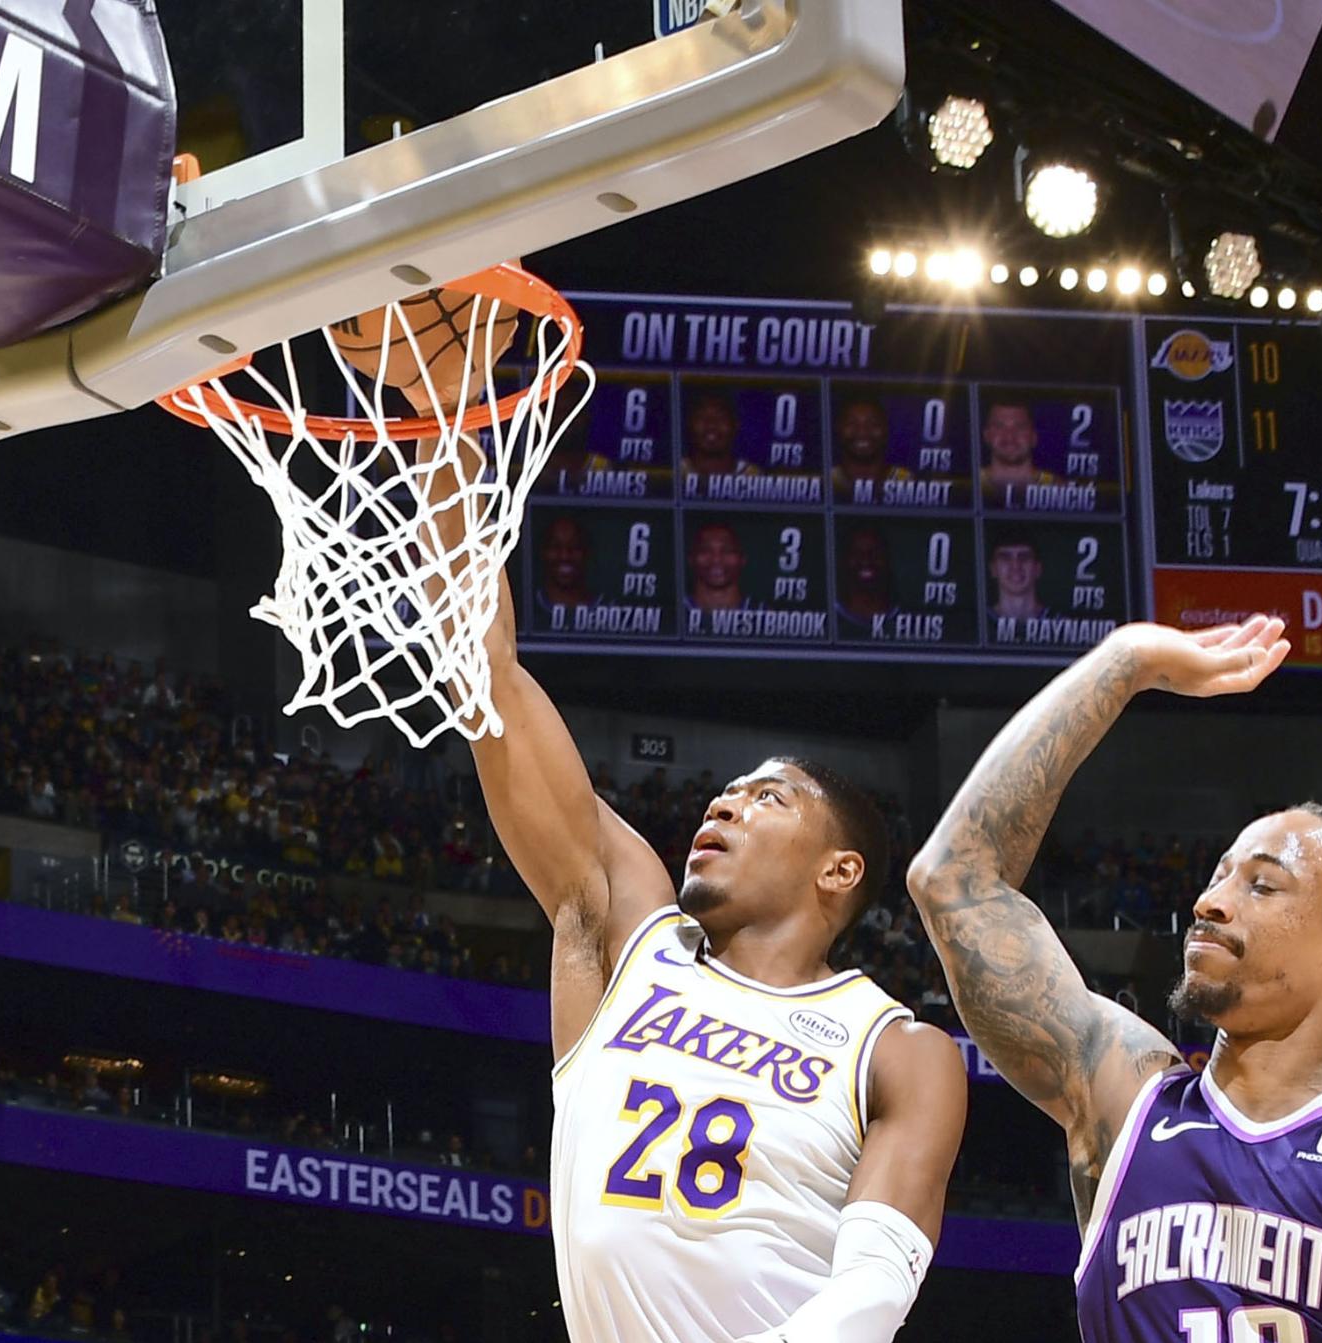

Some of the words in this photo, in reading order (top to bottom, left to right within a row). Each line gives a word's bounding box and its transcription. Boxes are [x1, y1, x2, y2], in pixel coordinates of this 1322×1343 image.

[623, 312, 676, 360] ON
[684, 314, 749, 364] THE
[756, 317, 876, 369] COURT
[1250, 342, 1279, 384] 10
[624, 389, 647, 433] 6
[774, 394, 797, 438] 0
[922, 399, 946, 442] 0
[1070, 404, 1093, 448] 2
[1252, 410, 1278, 451] 11
[620, 438, 653, 463] PTS
[770, 443, 804, 466] PTS
[919, 449, 952, 472] PTS
[1066, 453, 1100, 476] PTS
[580, 470, 648, 497] JAMES
[707, 474, 823, 501] HACHIMURA
[883, 480, 953, 507] SMART
[628, 522, 652, 568] 6
[779, 526, 803, 573] 3
[927, 532, 952, 577] 0
[1076, 536, 1099, 581] 2
[622, 573, 657, 598] PTS
[774, 578, 808, 602] PTS
[924, 581, 958, 607] PTS
[1072, 586, 1105, 610] PTS
[711, 608, 827, 639] WESTBROOK
[895, 614, 944, 642] ELLIS
[604, 983, 835, 1104] LAKERS
[600, 1075, 756, 1220] 28
[243, 1148, 517, 1225] EASTERSEALS
